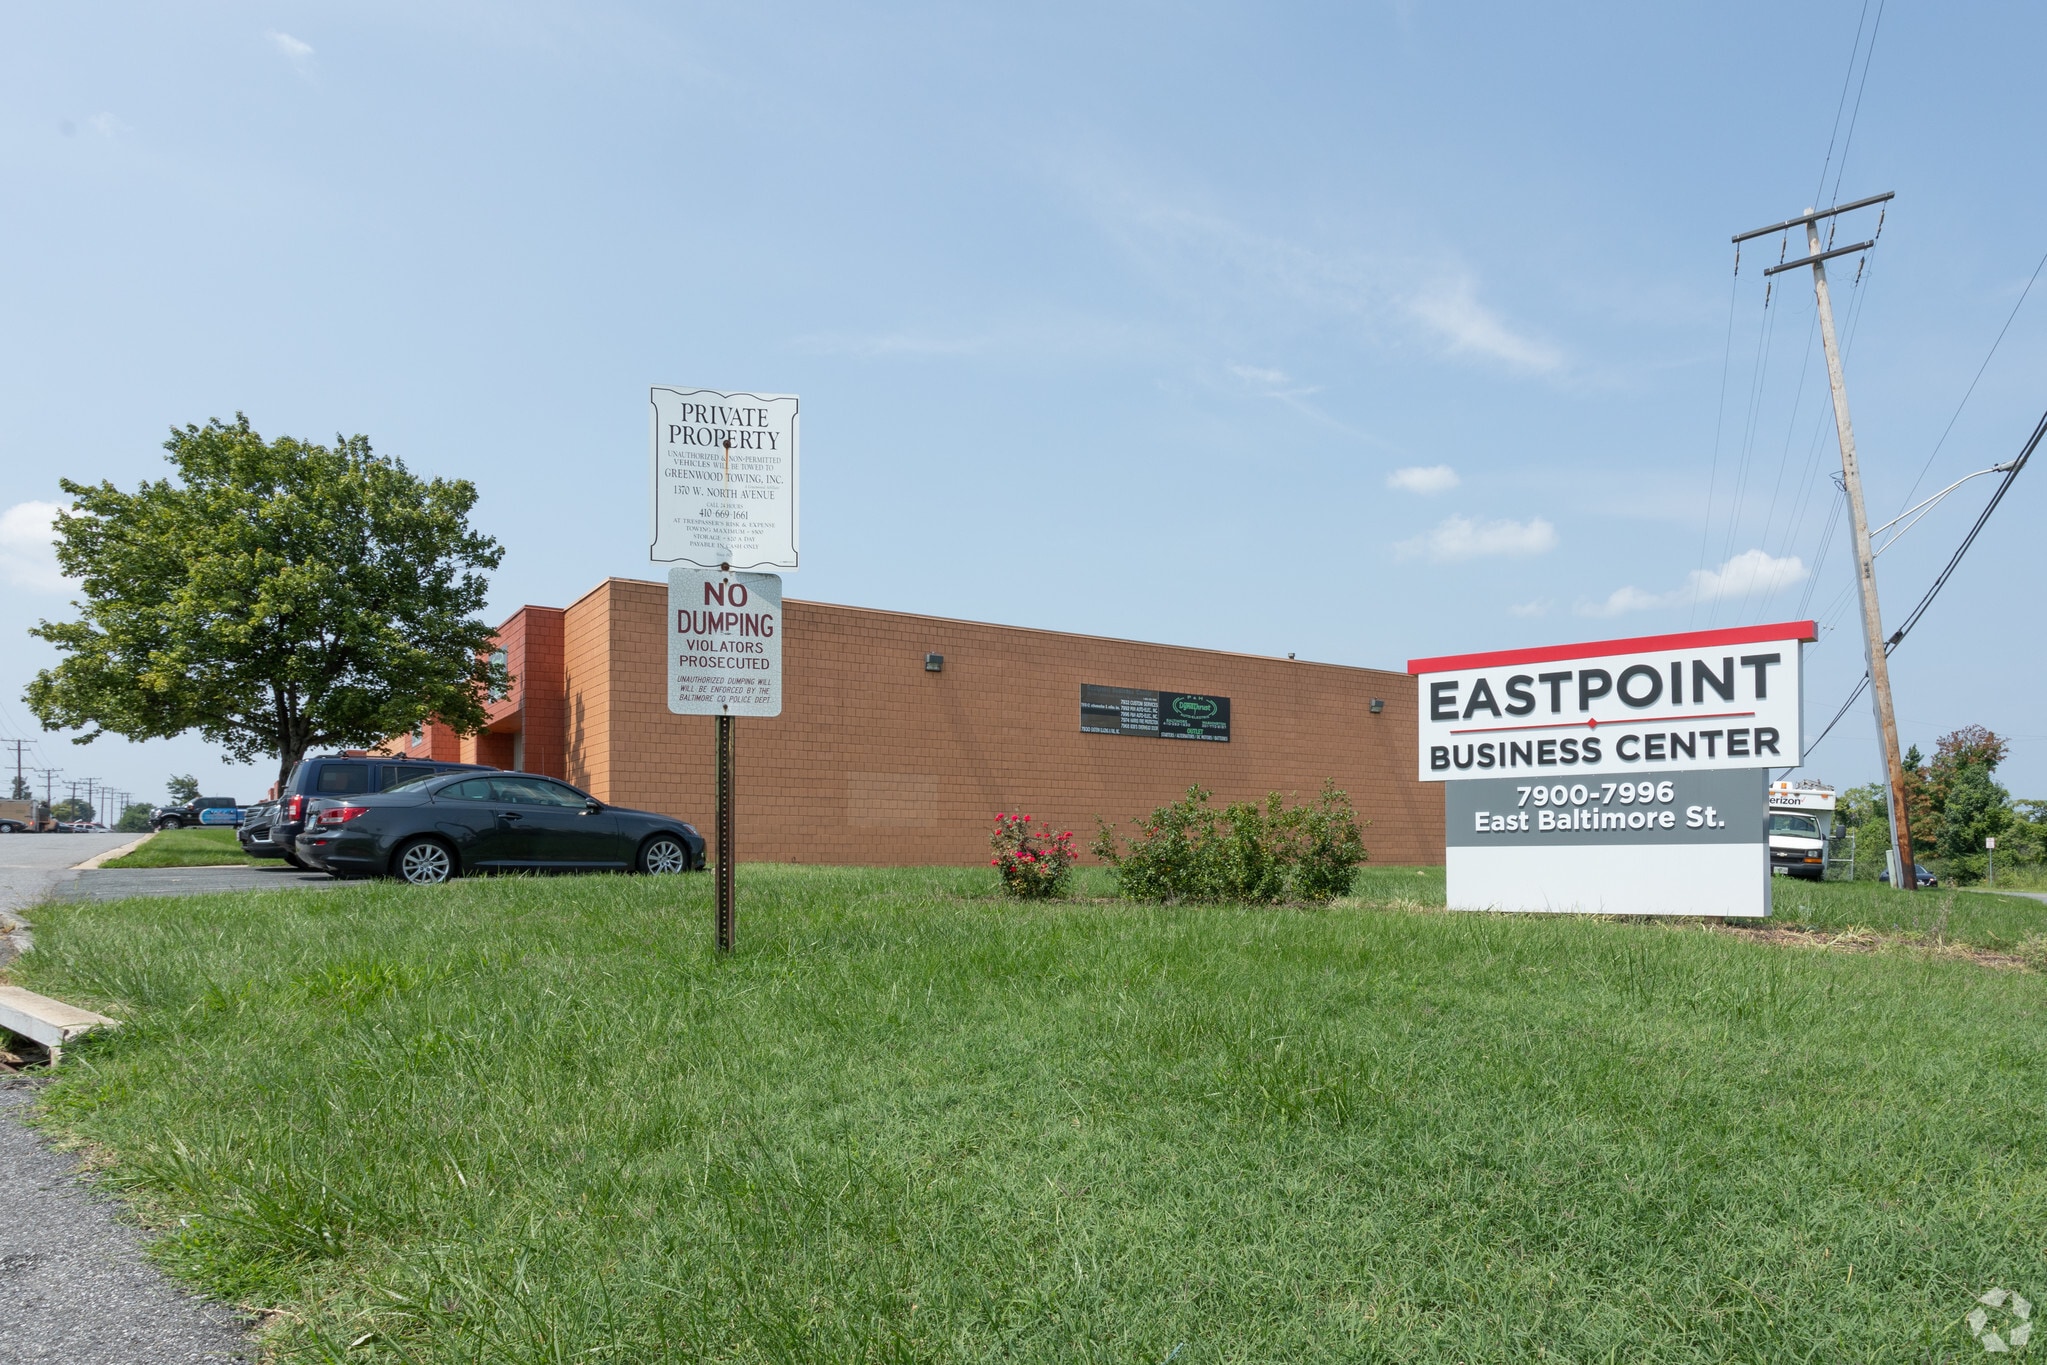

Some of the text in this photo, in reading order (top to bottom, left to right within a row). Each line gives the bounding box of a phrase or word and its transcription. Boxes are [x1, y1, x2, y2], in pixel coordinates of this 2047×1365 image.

[681, 403, 769, 427] PRIVATE
[669, 424, 780, 450] PROPERTY
[668, 450, 719, 461] UNAUTHORIZED
[729, 456, 781, 464] NON-PERMITTED
[674, 459, 711, 468] VEHICLES
[665, 468, 784, 484] GREENWOOD TOWING, INC.
[674, 485, 775, 500] 1370 W. NORTH AVENUE
[705, 582, 747, 607] NO
[678, 610, 773, 637] DUMPING
[687, 639, 764, 653] VIOLATORS
[680, 656, 770, 670] PROSECUTED
[677, 676, 724, 684] UNAUTHORIZED
[728, 677, 755, 685] DUMPING
[1430, 653, 1781, 721] EASTPOINT
[1430, 727, 1780, 771] BUSINESS CENTER
[1517, 781, 1674, 808] 7900-7996
[1769, 796, 1801, 805] erizon
[1475, 806, 1725, 833] East Baltimore St.
